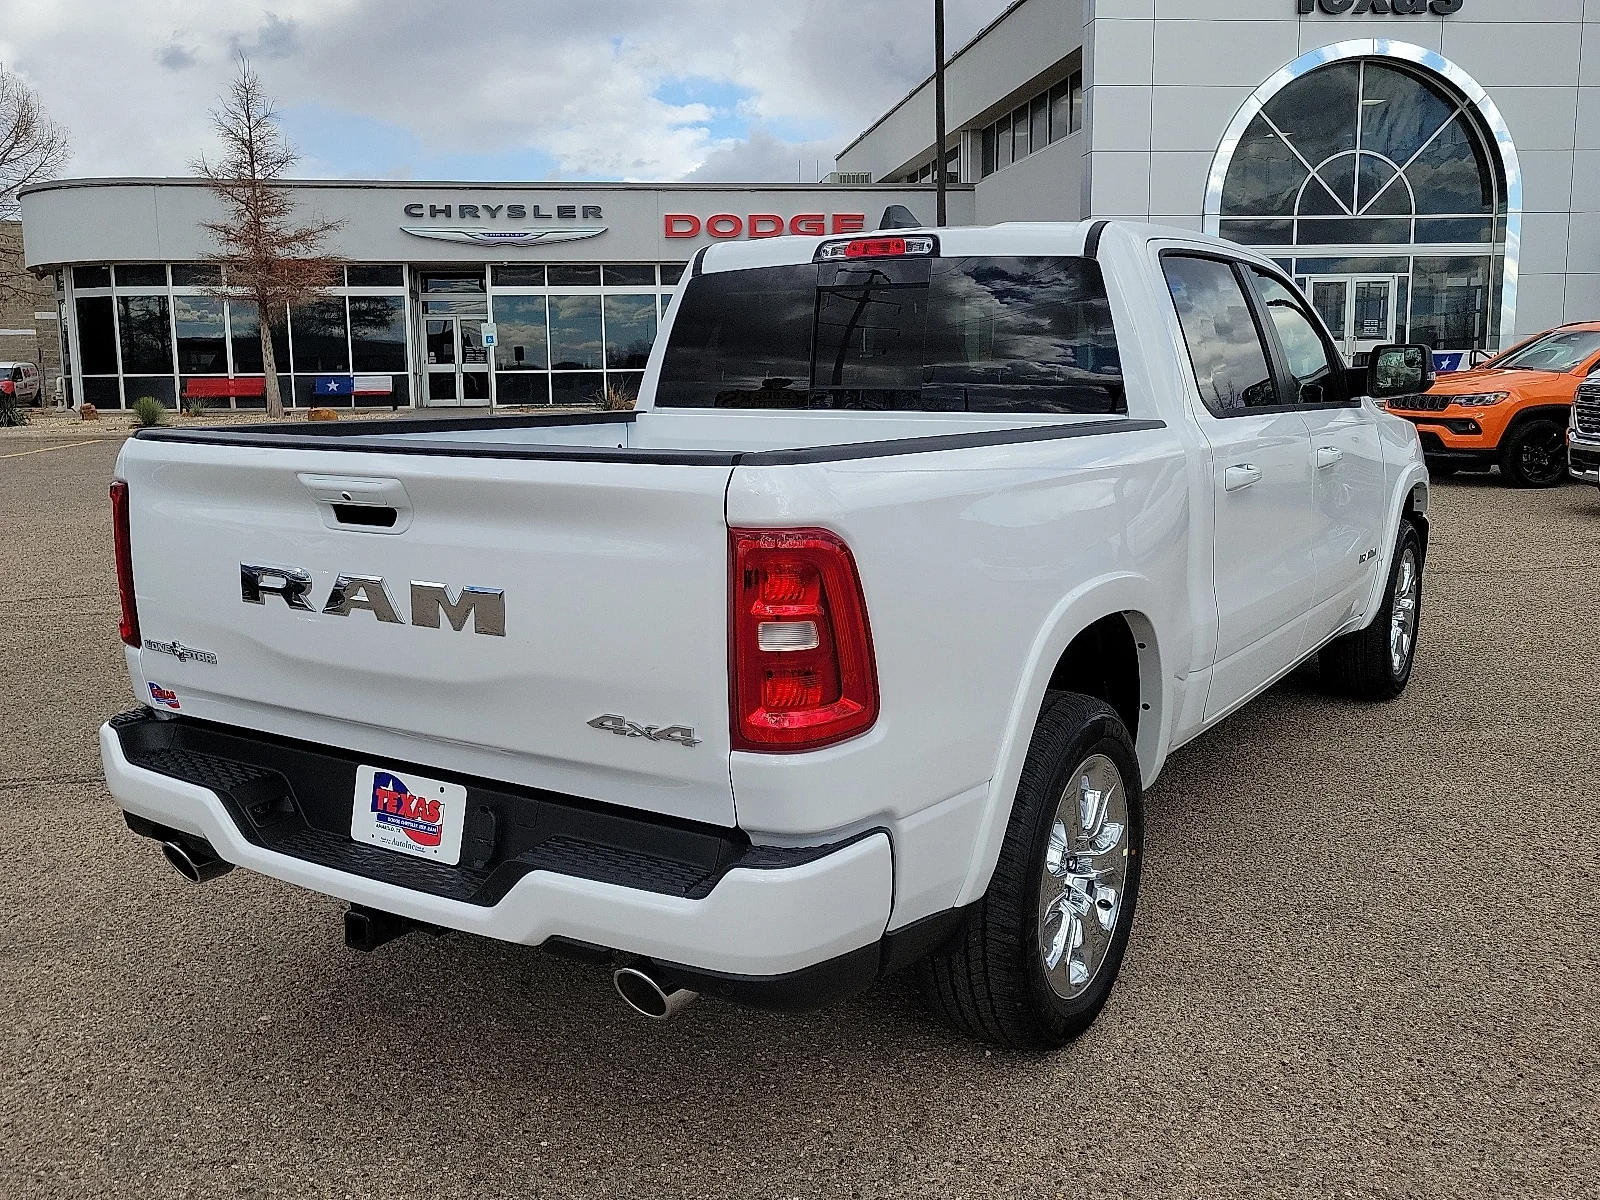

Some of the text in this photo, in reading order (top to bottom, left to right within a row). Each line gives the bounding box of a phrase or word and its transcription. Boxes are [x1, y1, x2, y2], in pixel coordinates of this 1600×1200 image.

[403, 203, 604, 219] CHRYSLER
[664, 213, 865, 239] DODGE
[240, 561, 506, 637] RAM
[144, 640, 218, 665] LONE STAR
[376, 788, 440, 823] TEXAS
